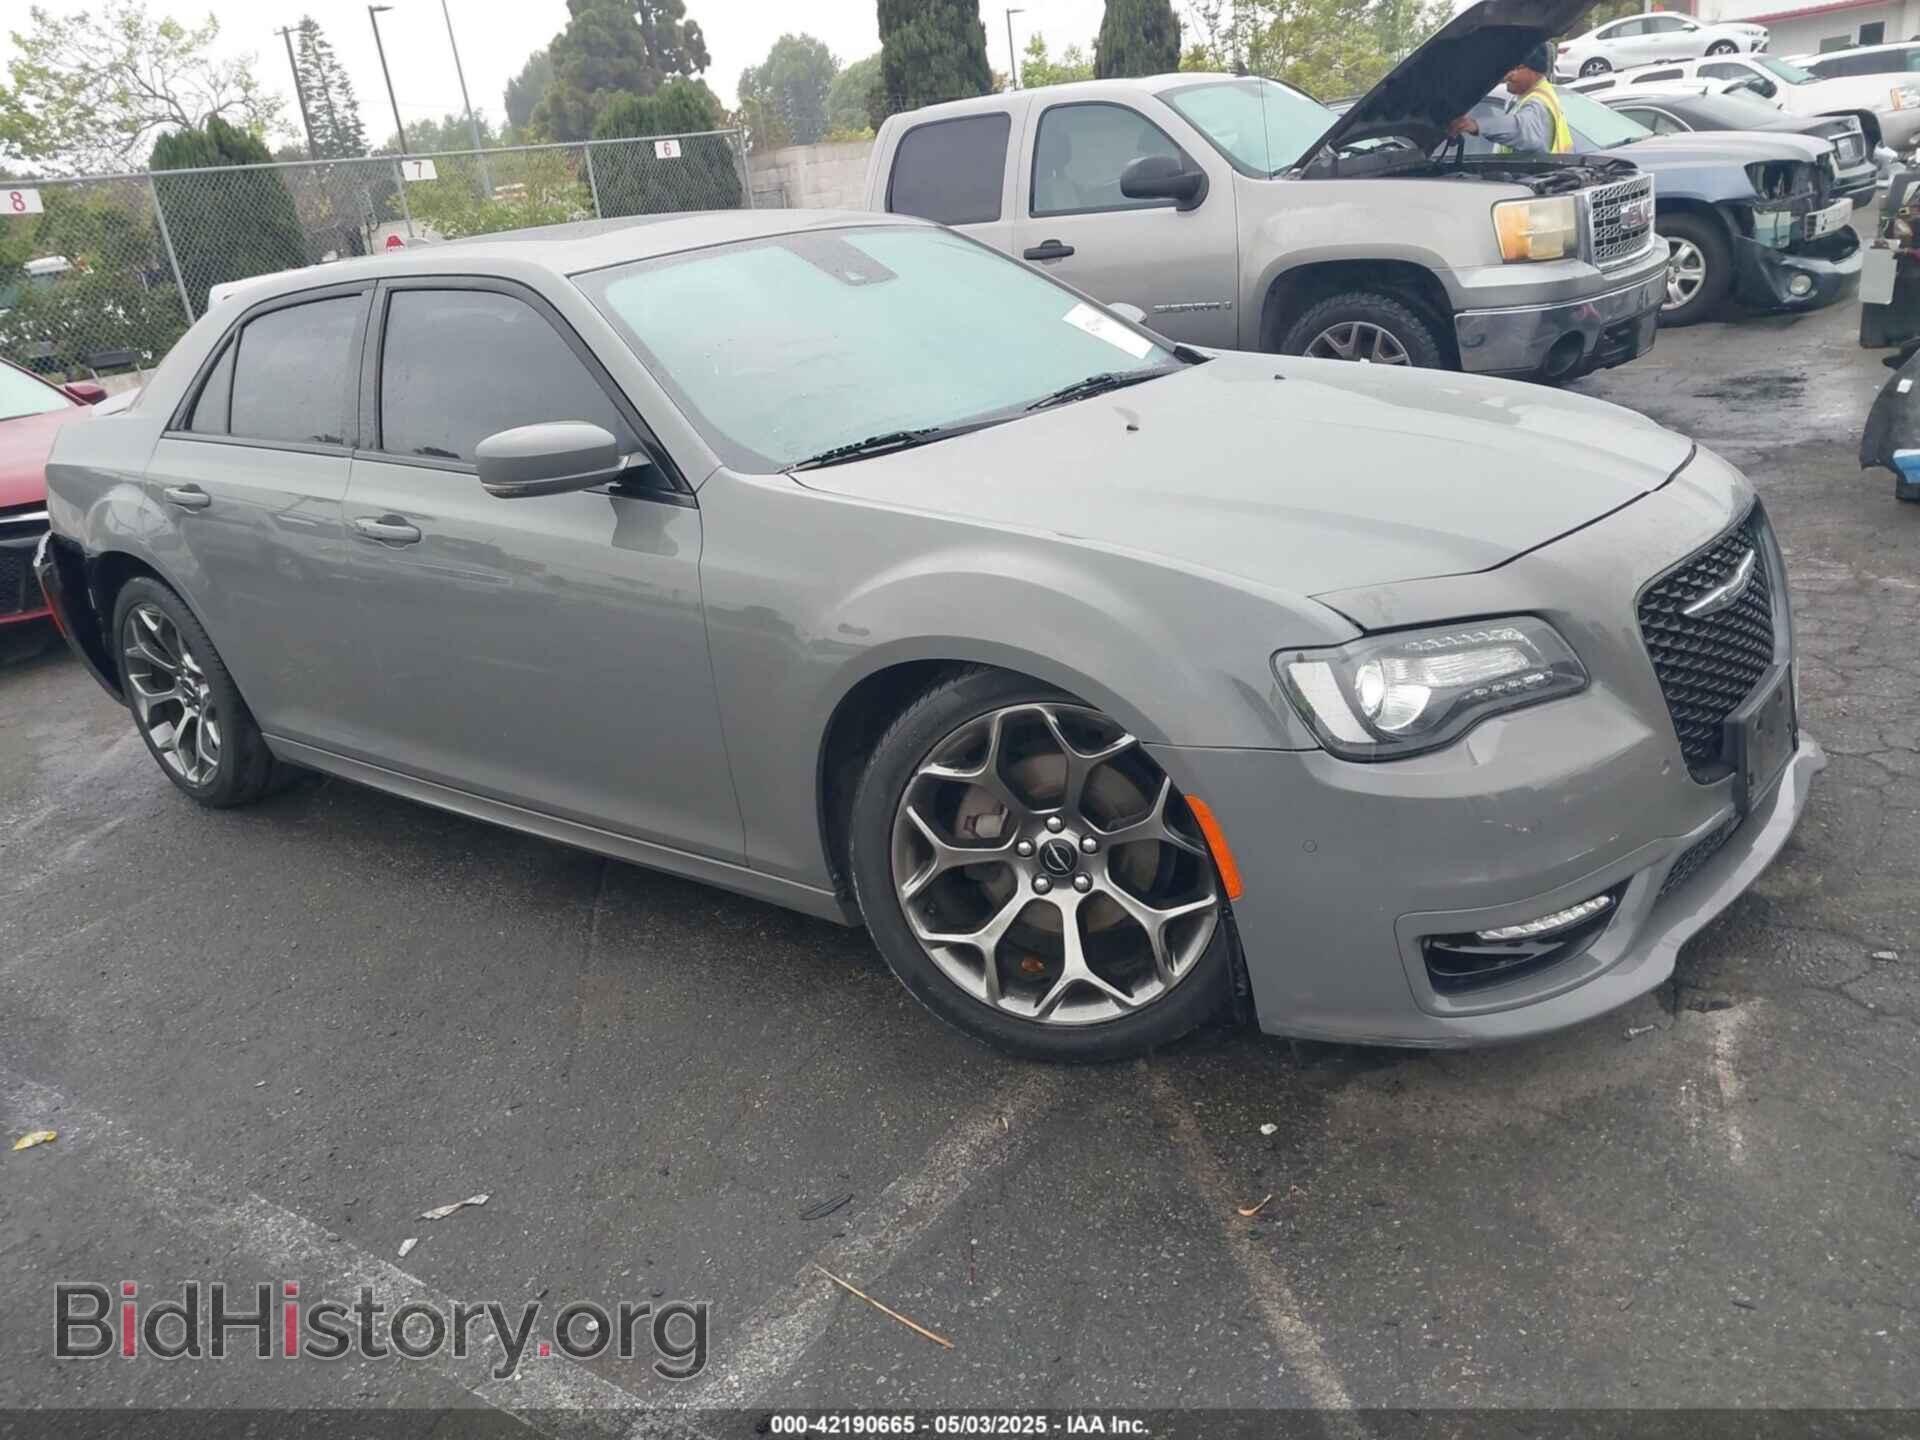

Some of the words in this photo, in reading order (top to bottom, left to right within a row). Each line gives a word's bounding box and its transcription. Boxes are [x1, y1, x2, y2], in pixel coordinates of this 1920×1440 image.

[663, 141, 672, 156] 6
[413, 160, 422, 178] 7
[9, 190, 26, 212] 8
